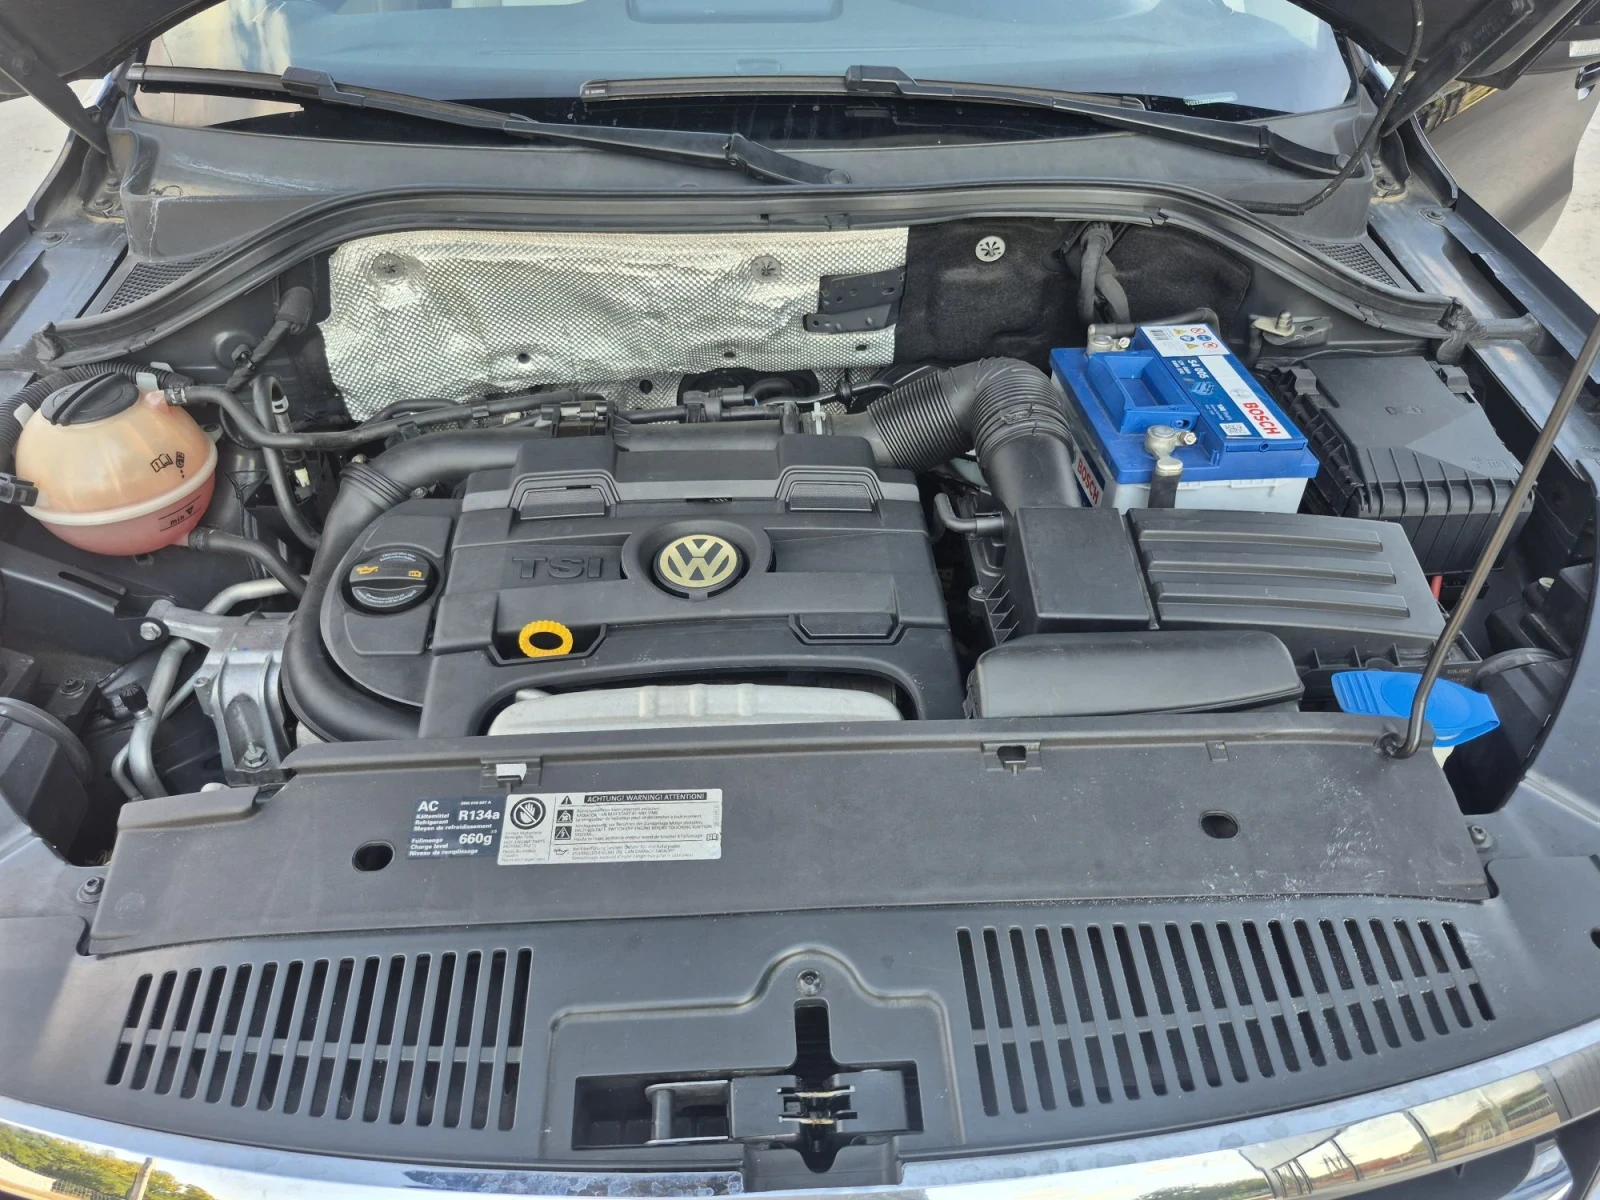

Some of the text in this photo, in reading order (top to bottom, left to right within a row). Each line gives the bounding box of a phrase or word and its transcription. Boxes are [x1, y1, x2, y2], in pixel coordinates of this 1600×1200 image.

[1242, 402, 1281, 435] BOSCH
[1077, 458, 1100, 505] BOSCH
[170, 515, 185, 526] min
[512, 556, 604, 580] TSI
[660, 536, 736, 587] VW
[418, 800, 440, 812] AC
[458, 810, 500, 821] R134a
[459, 833, 492, 846] 660g
